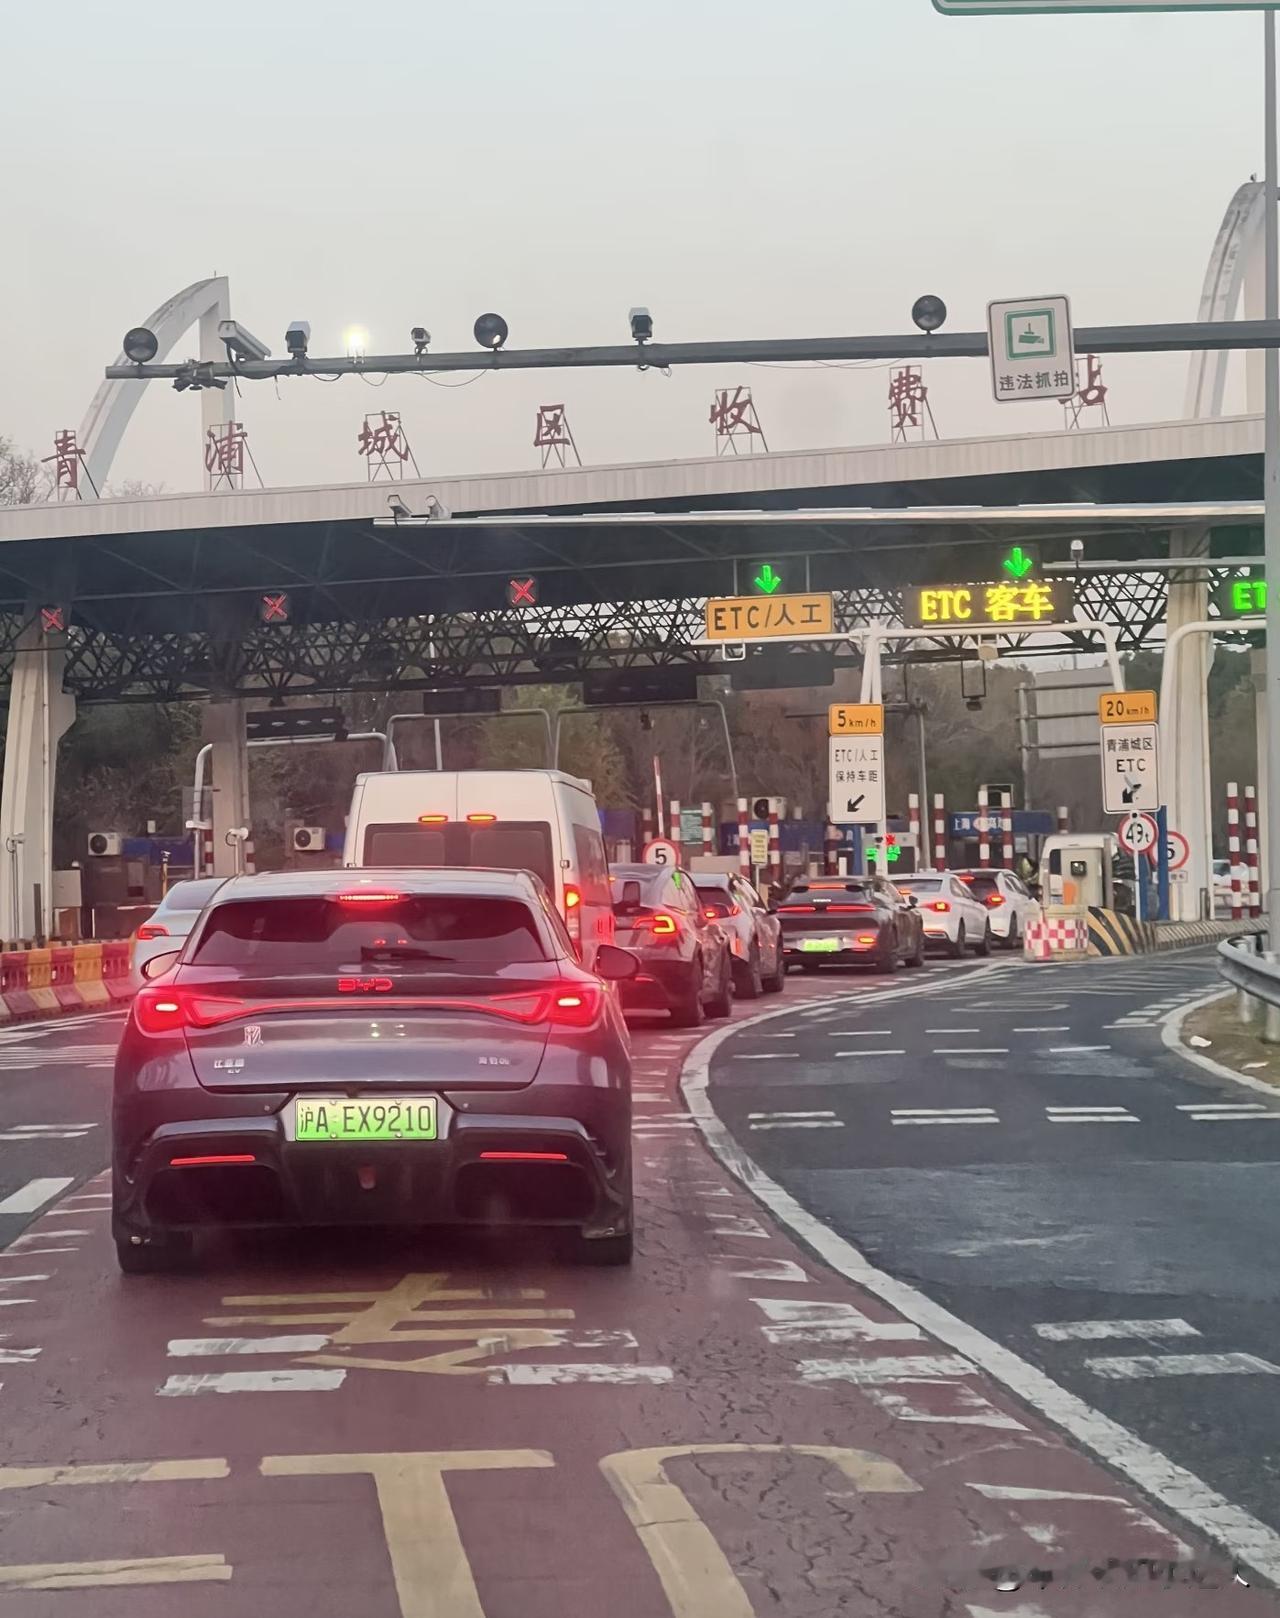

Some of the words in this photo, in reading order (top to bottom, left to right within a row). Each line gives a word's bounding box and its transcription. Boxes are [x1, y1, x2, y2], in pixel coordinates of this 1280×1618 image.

[999, 370, 1069, 391] 违法抓拍
[921, 590, 971, 620] ETC
[985, 585, 1054, 621] 客车
[714, 603, 822, 631] ETC/人工
[1107, 737, 1153, 752] 青浦城区
[835, 749, 878, 762] ETC/人工
[1116, 758, 1146, 772] ETC
[836, 770, 878, 782] 保持车距
[655, 848, 667, 865] 5
[338, 977, 393, 992] BYD
[300, 1107, 329, 1133] 沪A
[343, 1106, 431, 1133] EX9210
